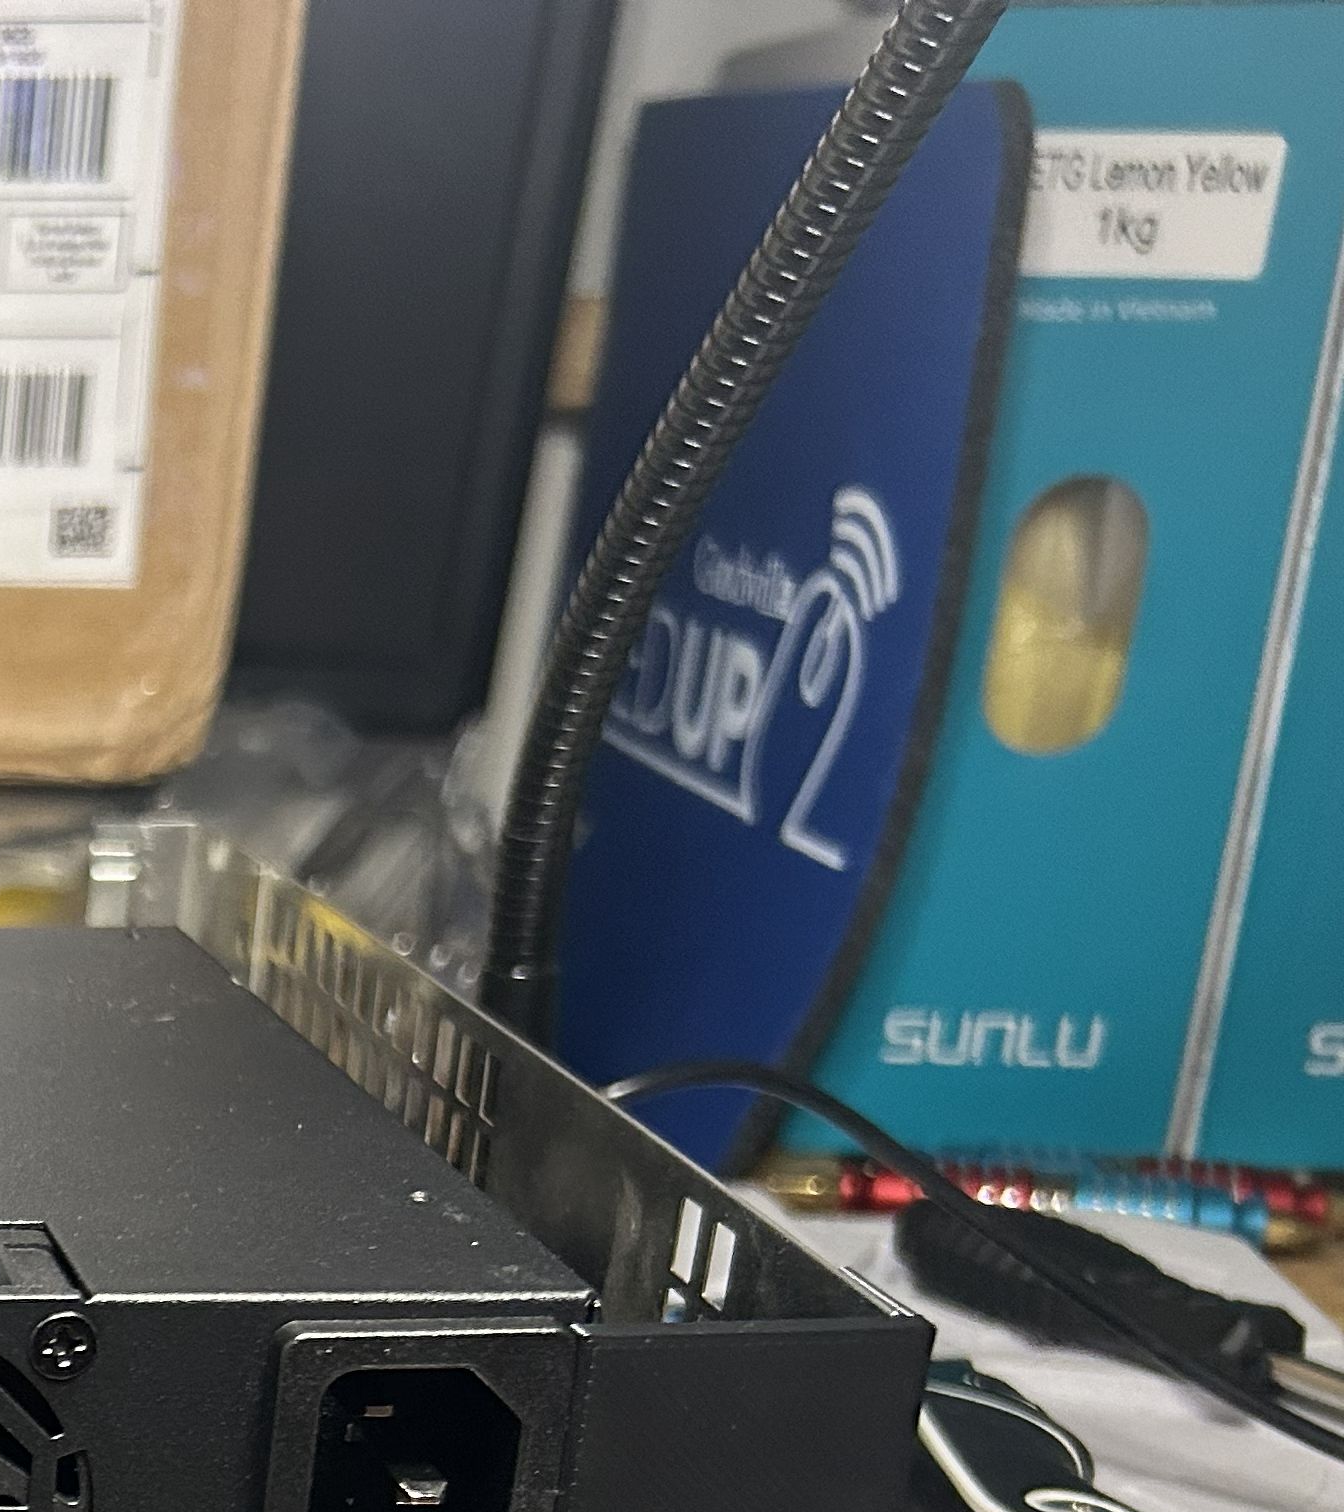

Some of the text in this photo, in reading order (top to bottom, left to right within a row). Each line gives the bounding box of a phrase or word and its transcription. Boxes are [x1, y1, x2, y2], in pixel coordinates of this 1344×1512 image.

[1089, 151, 1178, 193] Lemon
[1184, 153, 1272, 193] Yellow
[879, 1004, 1108, 1069] SUNLU
